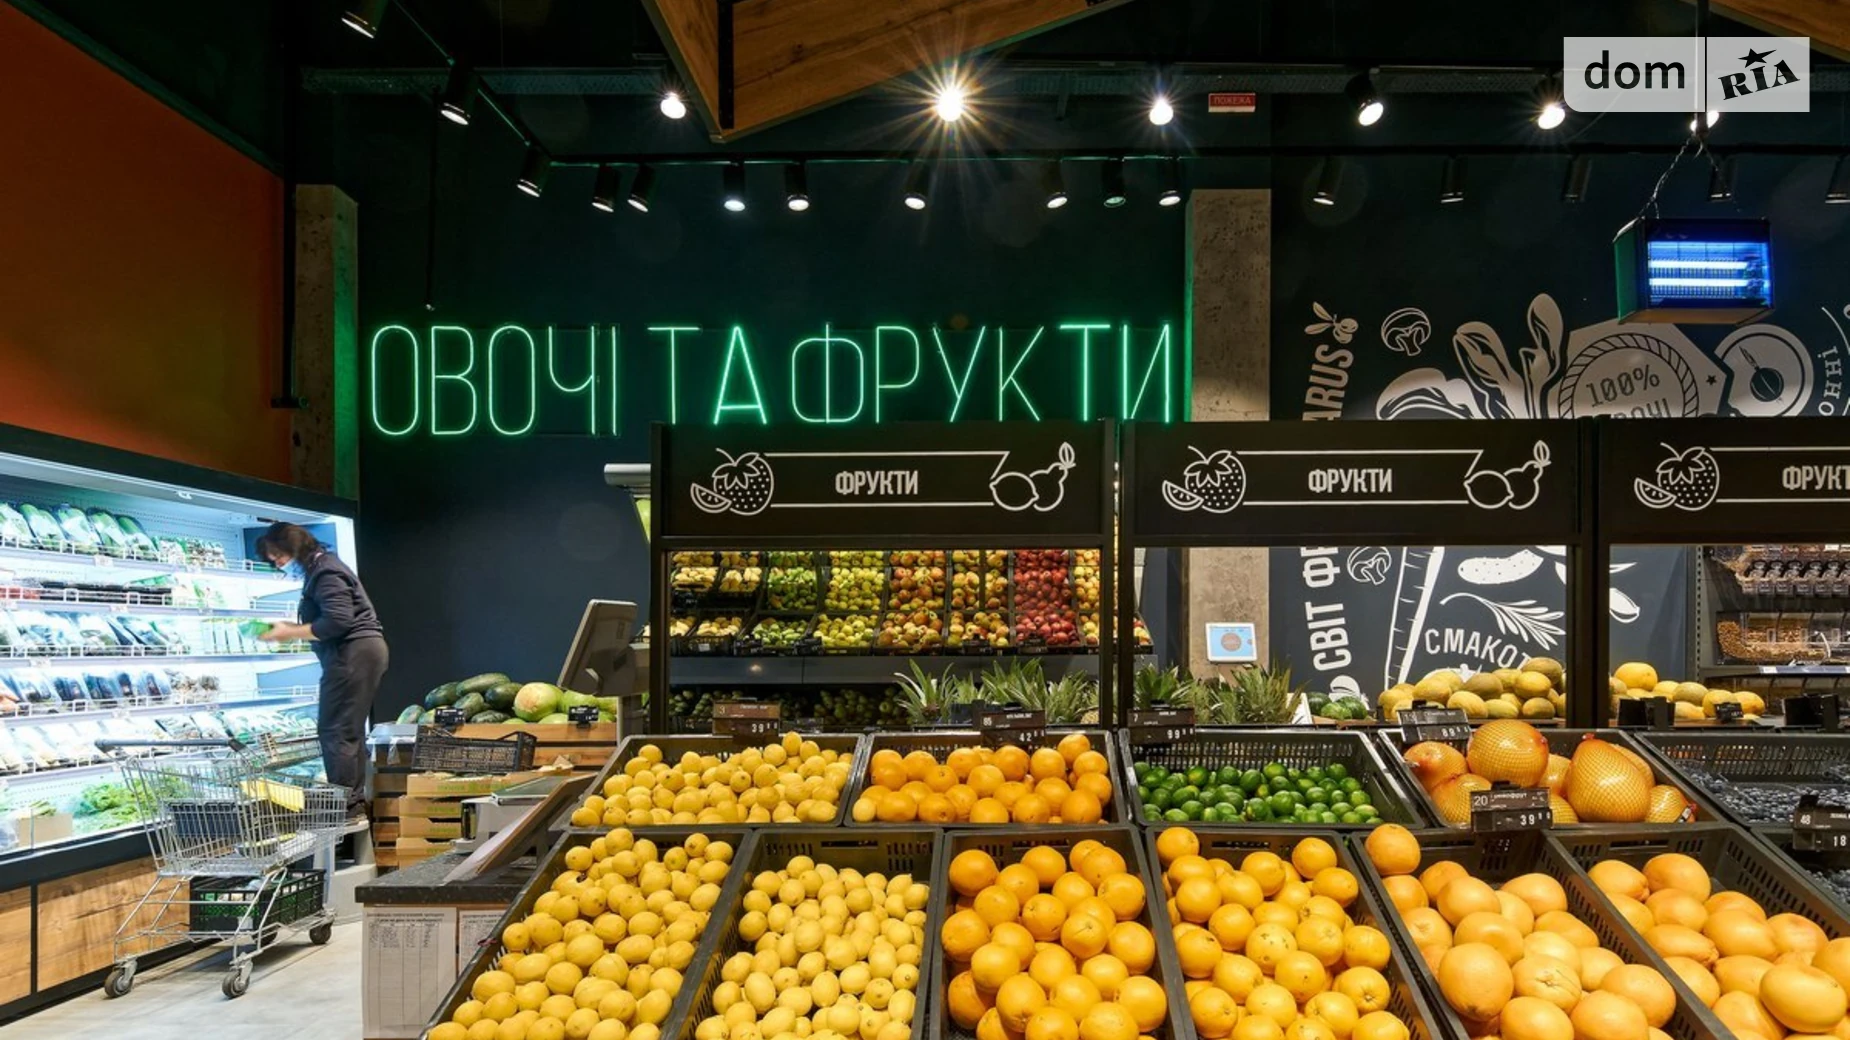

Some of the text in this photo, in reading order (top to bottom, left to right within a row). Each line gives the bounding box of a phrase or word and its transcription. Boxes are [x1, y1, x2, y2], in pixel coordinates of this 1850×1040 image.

[371, 323, 1171, 436] ОВОЧІ ТА ФРУКТИ
[1586, 364, 1660, 408] 100%
[835, 470, 919, 496] ФРУКТИ
[1308, 468, 1393, 494] ФРУКТИ
[1782, 465, 1850, 491] ФРУКТ
[1304, 601, 1352, 671] СВІТ
[1473, 795, 1488, 806] 20
